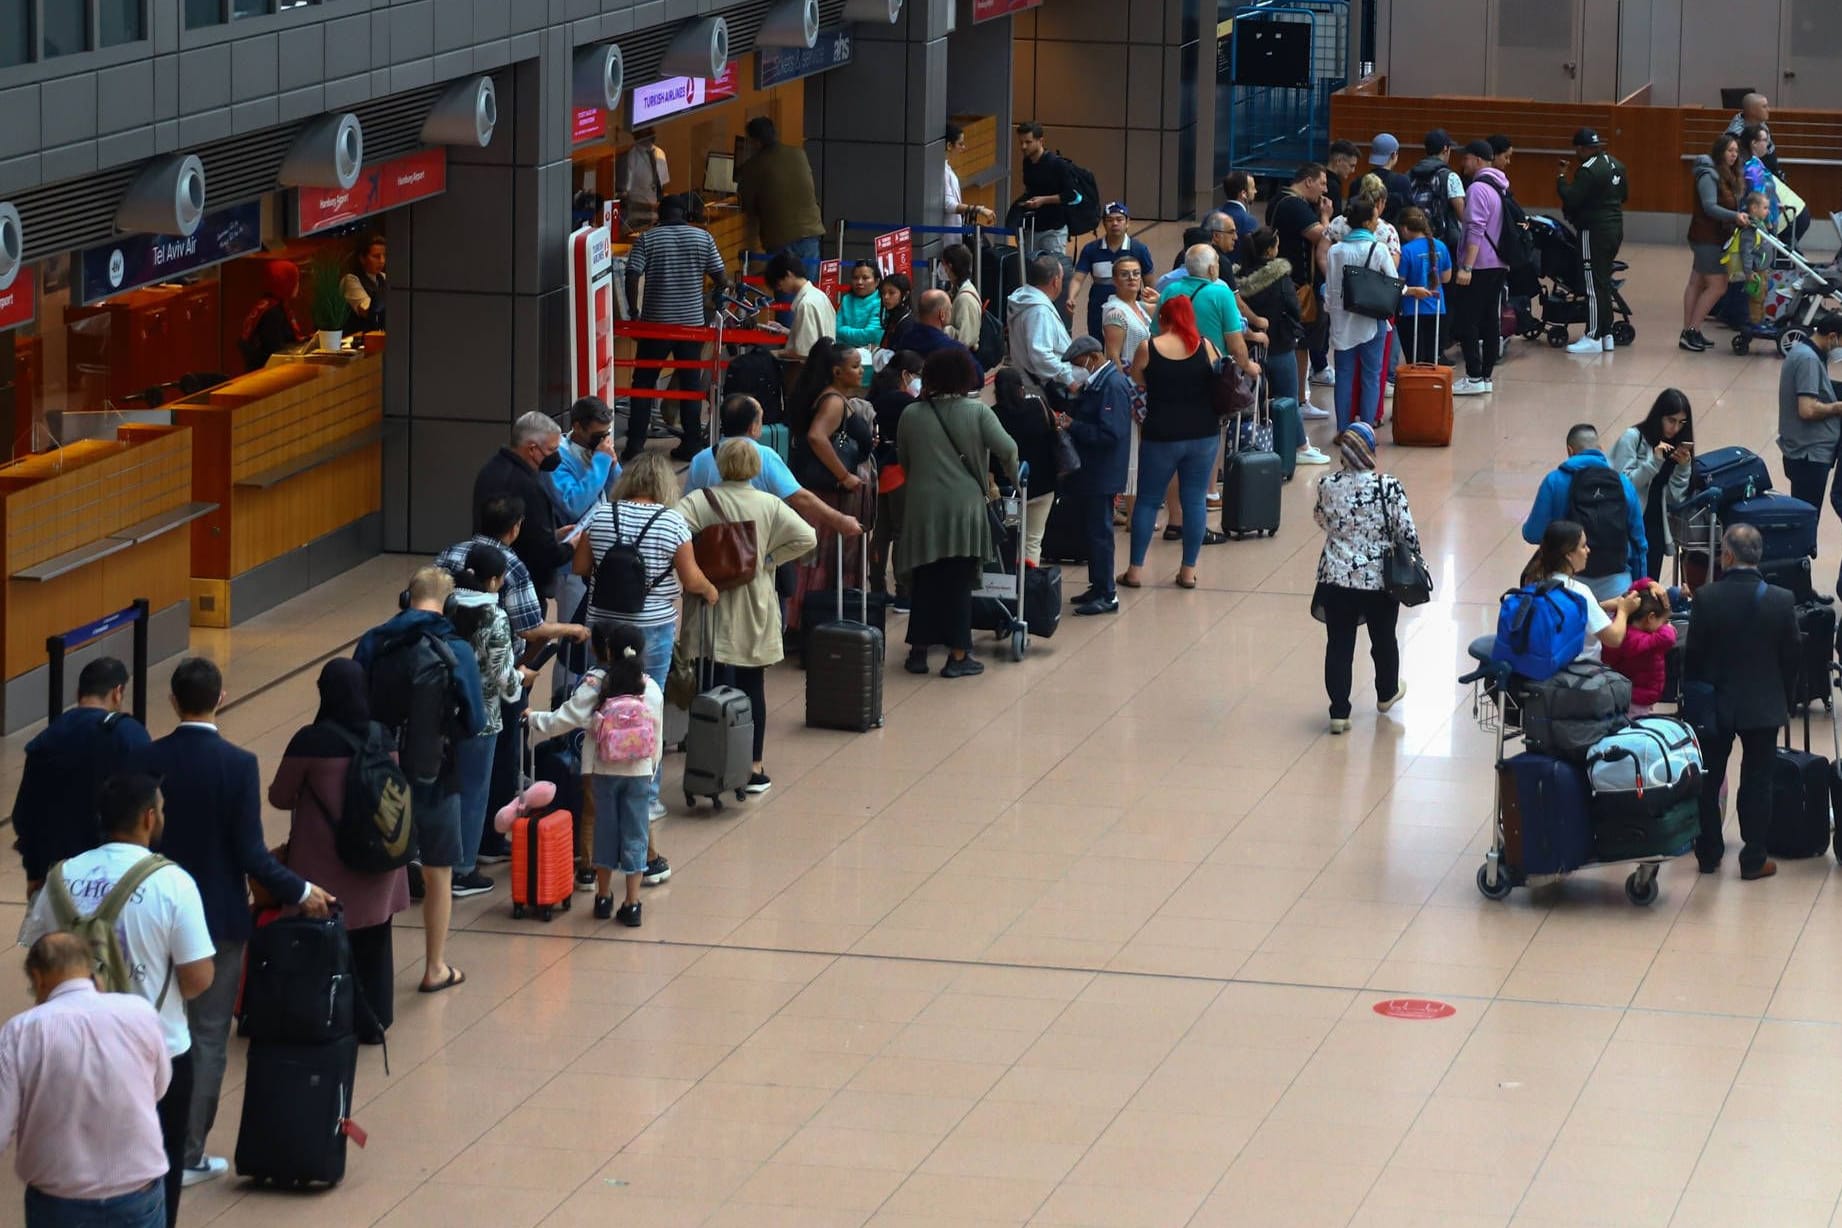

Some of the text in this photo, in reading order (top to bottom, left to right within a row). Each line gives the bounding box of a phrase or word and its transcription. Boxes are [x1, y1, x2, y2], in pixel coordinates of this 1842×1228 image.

[643, 86, 686, 108] TURKISH AIRLINES
[152, 244, 165, 265] Tel
[166, 240, 185, 261] Aviv
[185, 236, 198, 256] Air
